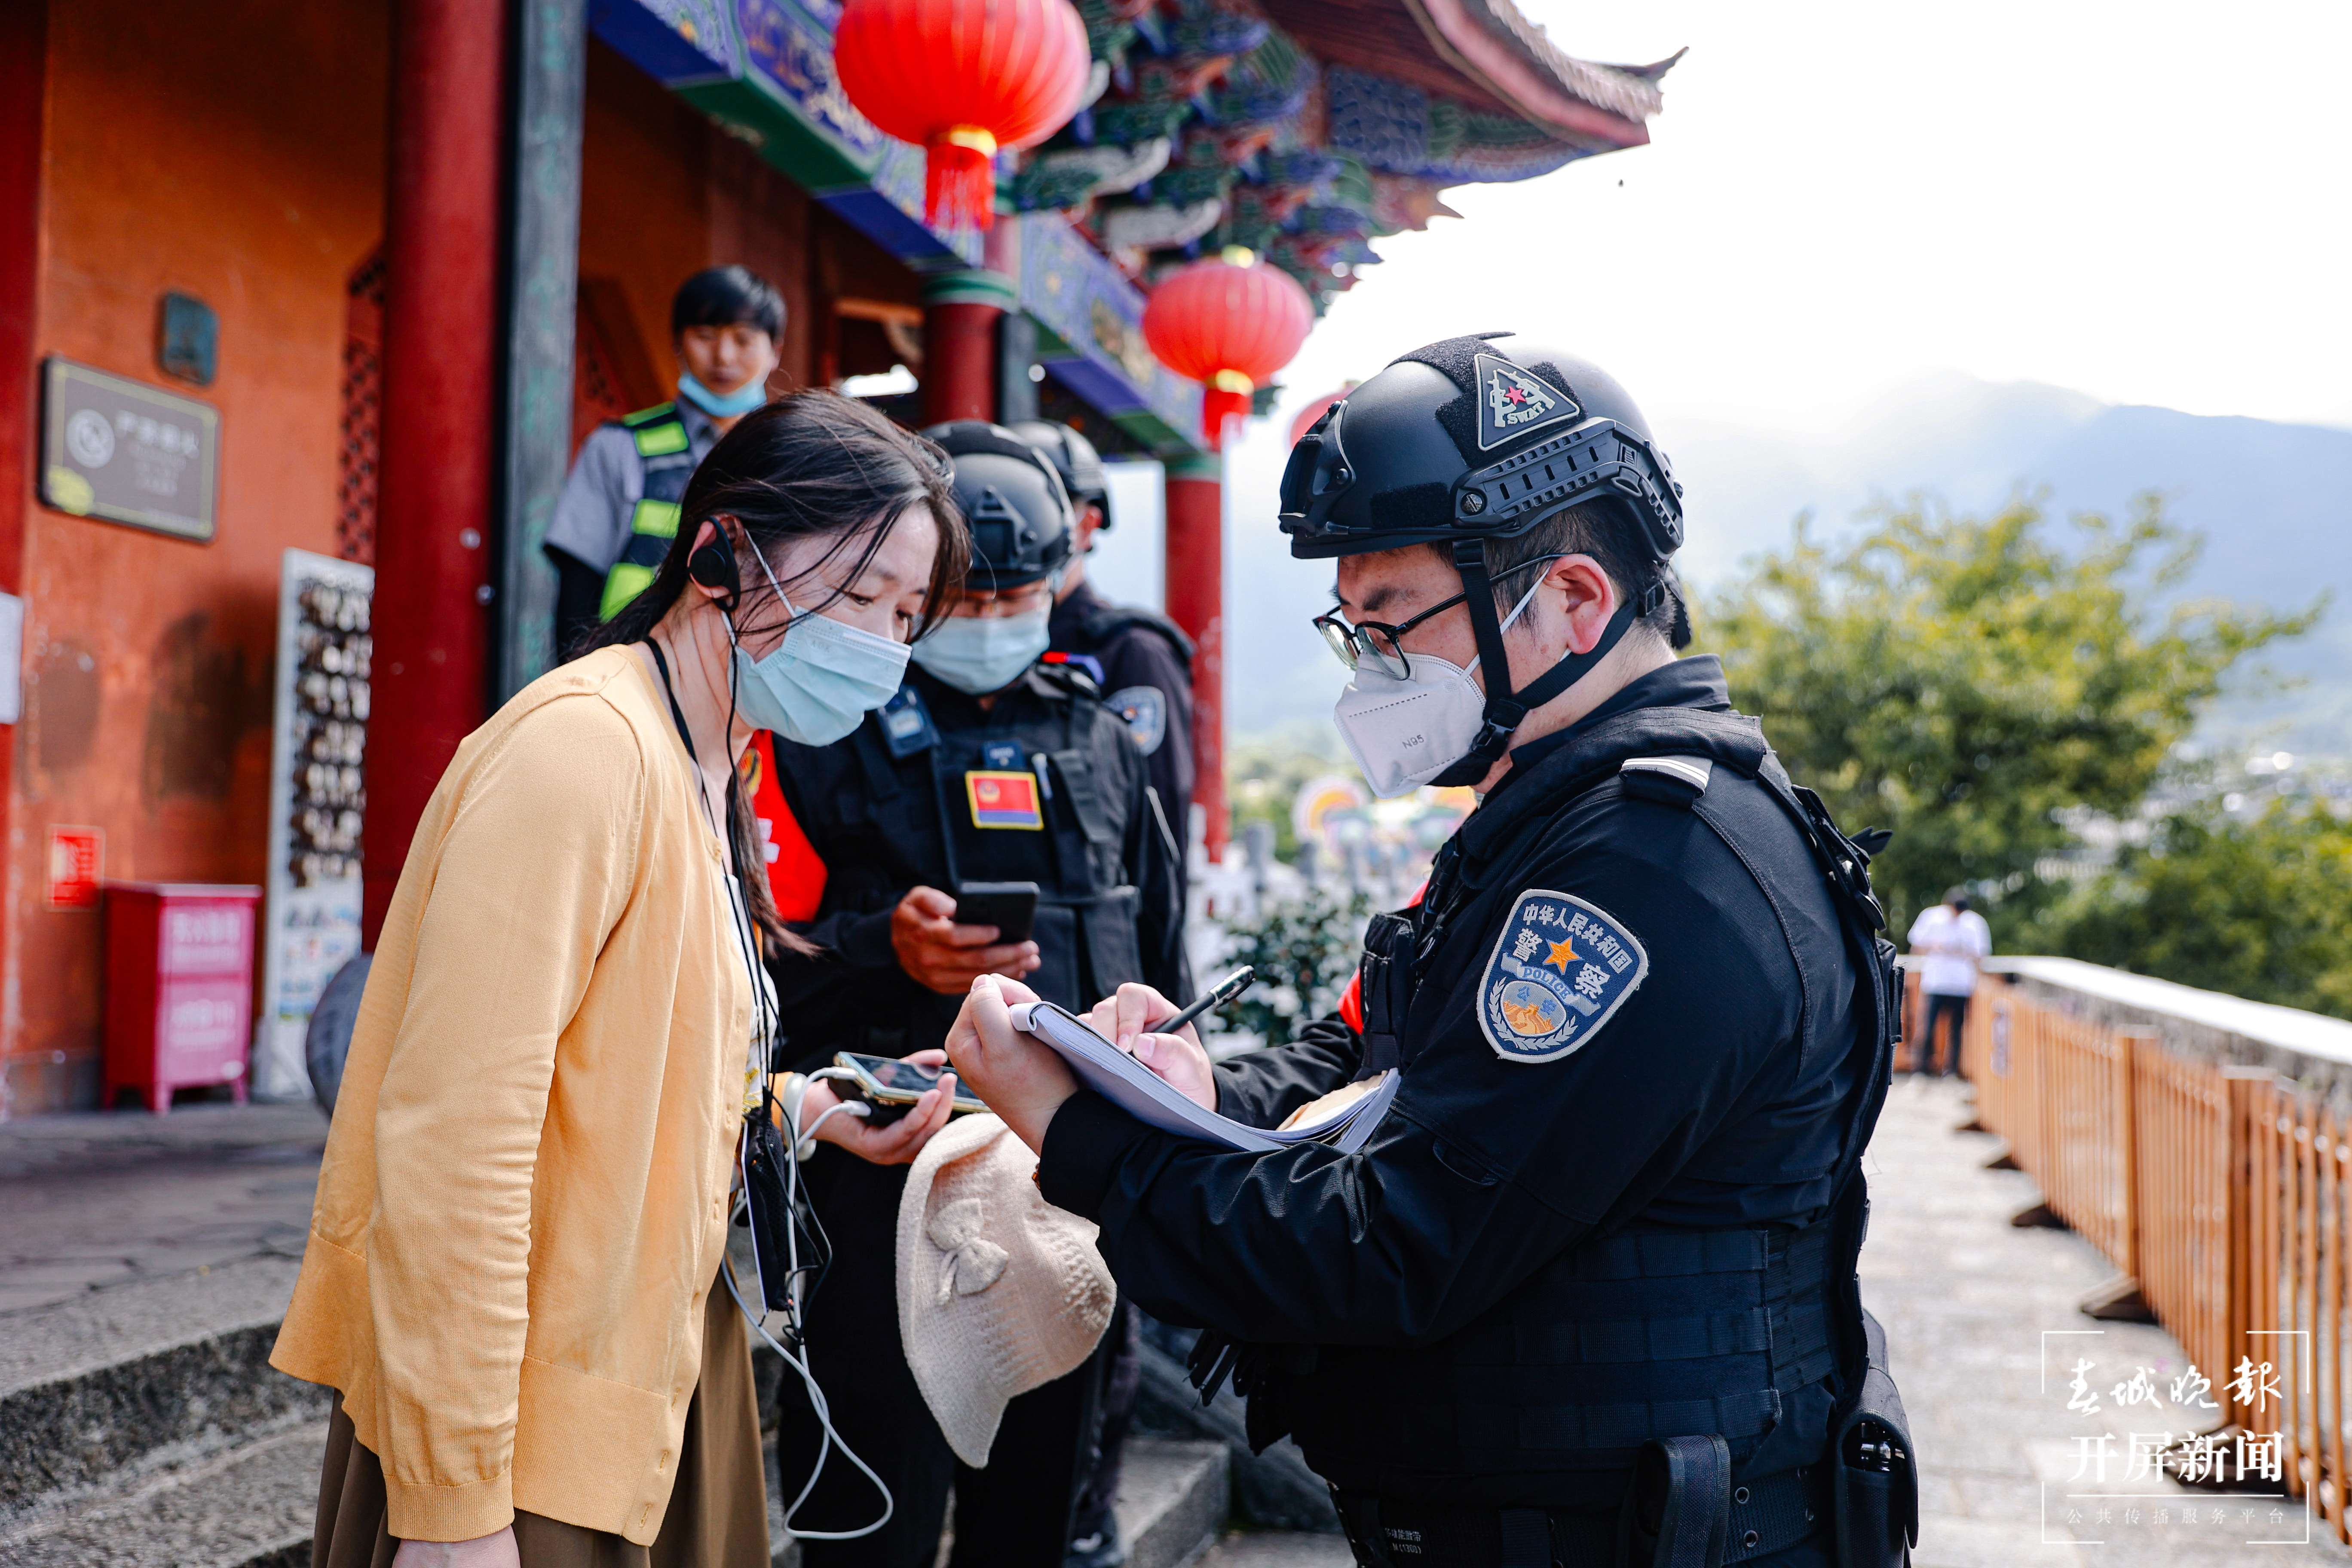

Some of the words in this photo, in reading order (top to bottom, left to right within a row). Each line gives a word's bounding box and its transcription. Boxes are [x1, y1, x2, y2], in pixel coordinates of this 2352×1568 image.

[1507, 402, 1545, 425] SWAT
[1402, 734, 1425, 750] N95
[1523, 903, 1633, 974] 中华人民共和国
[1522, 966, 1573, 1000] POLICE
